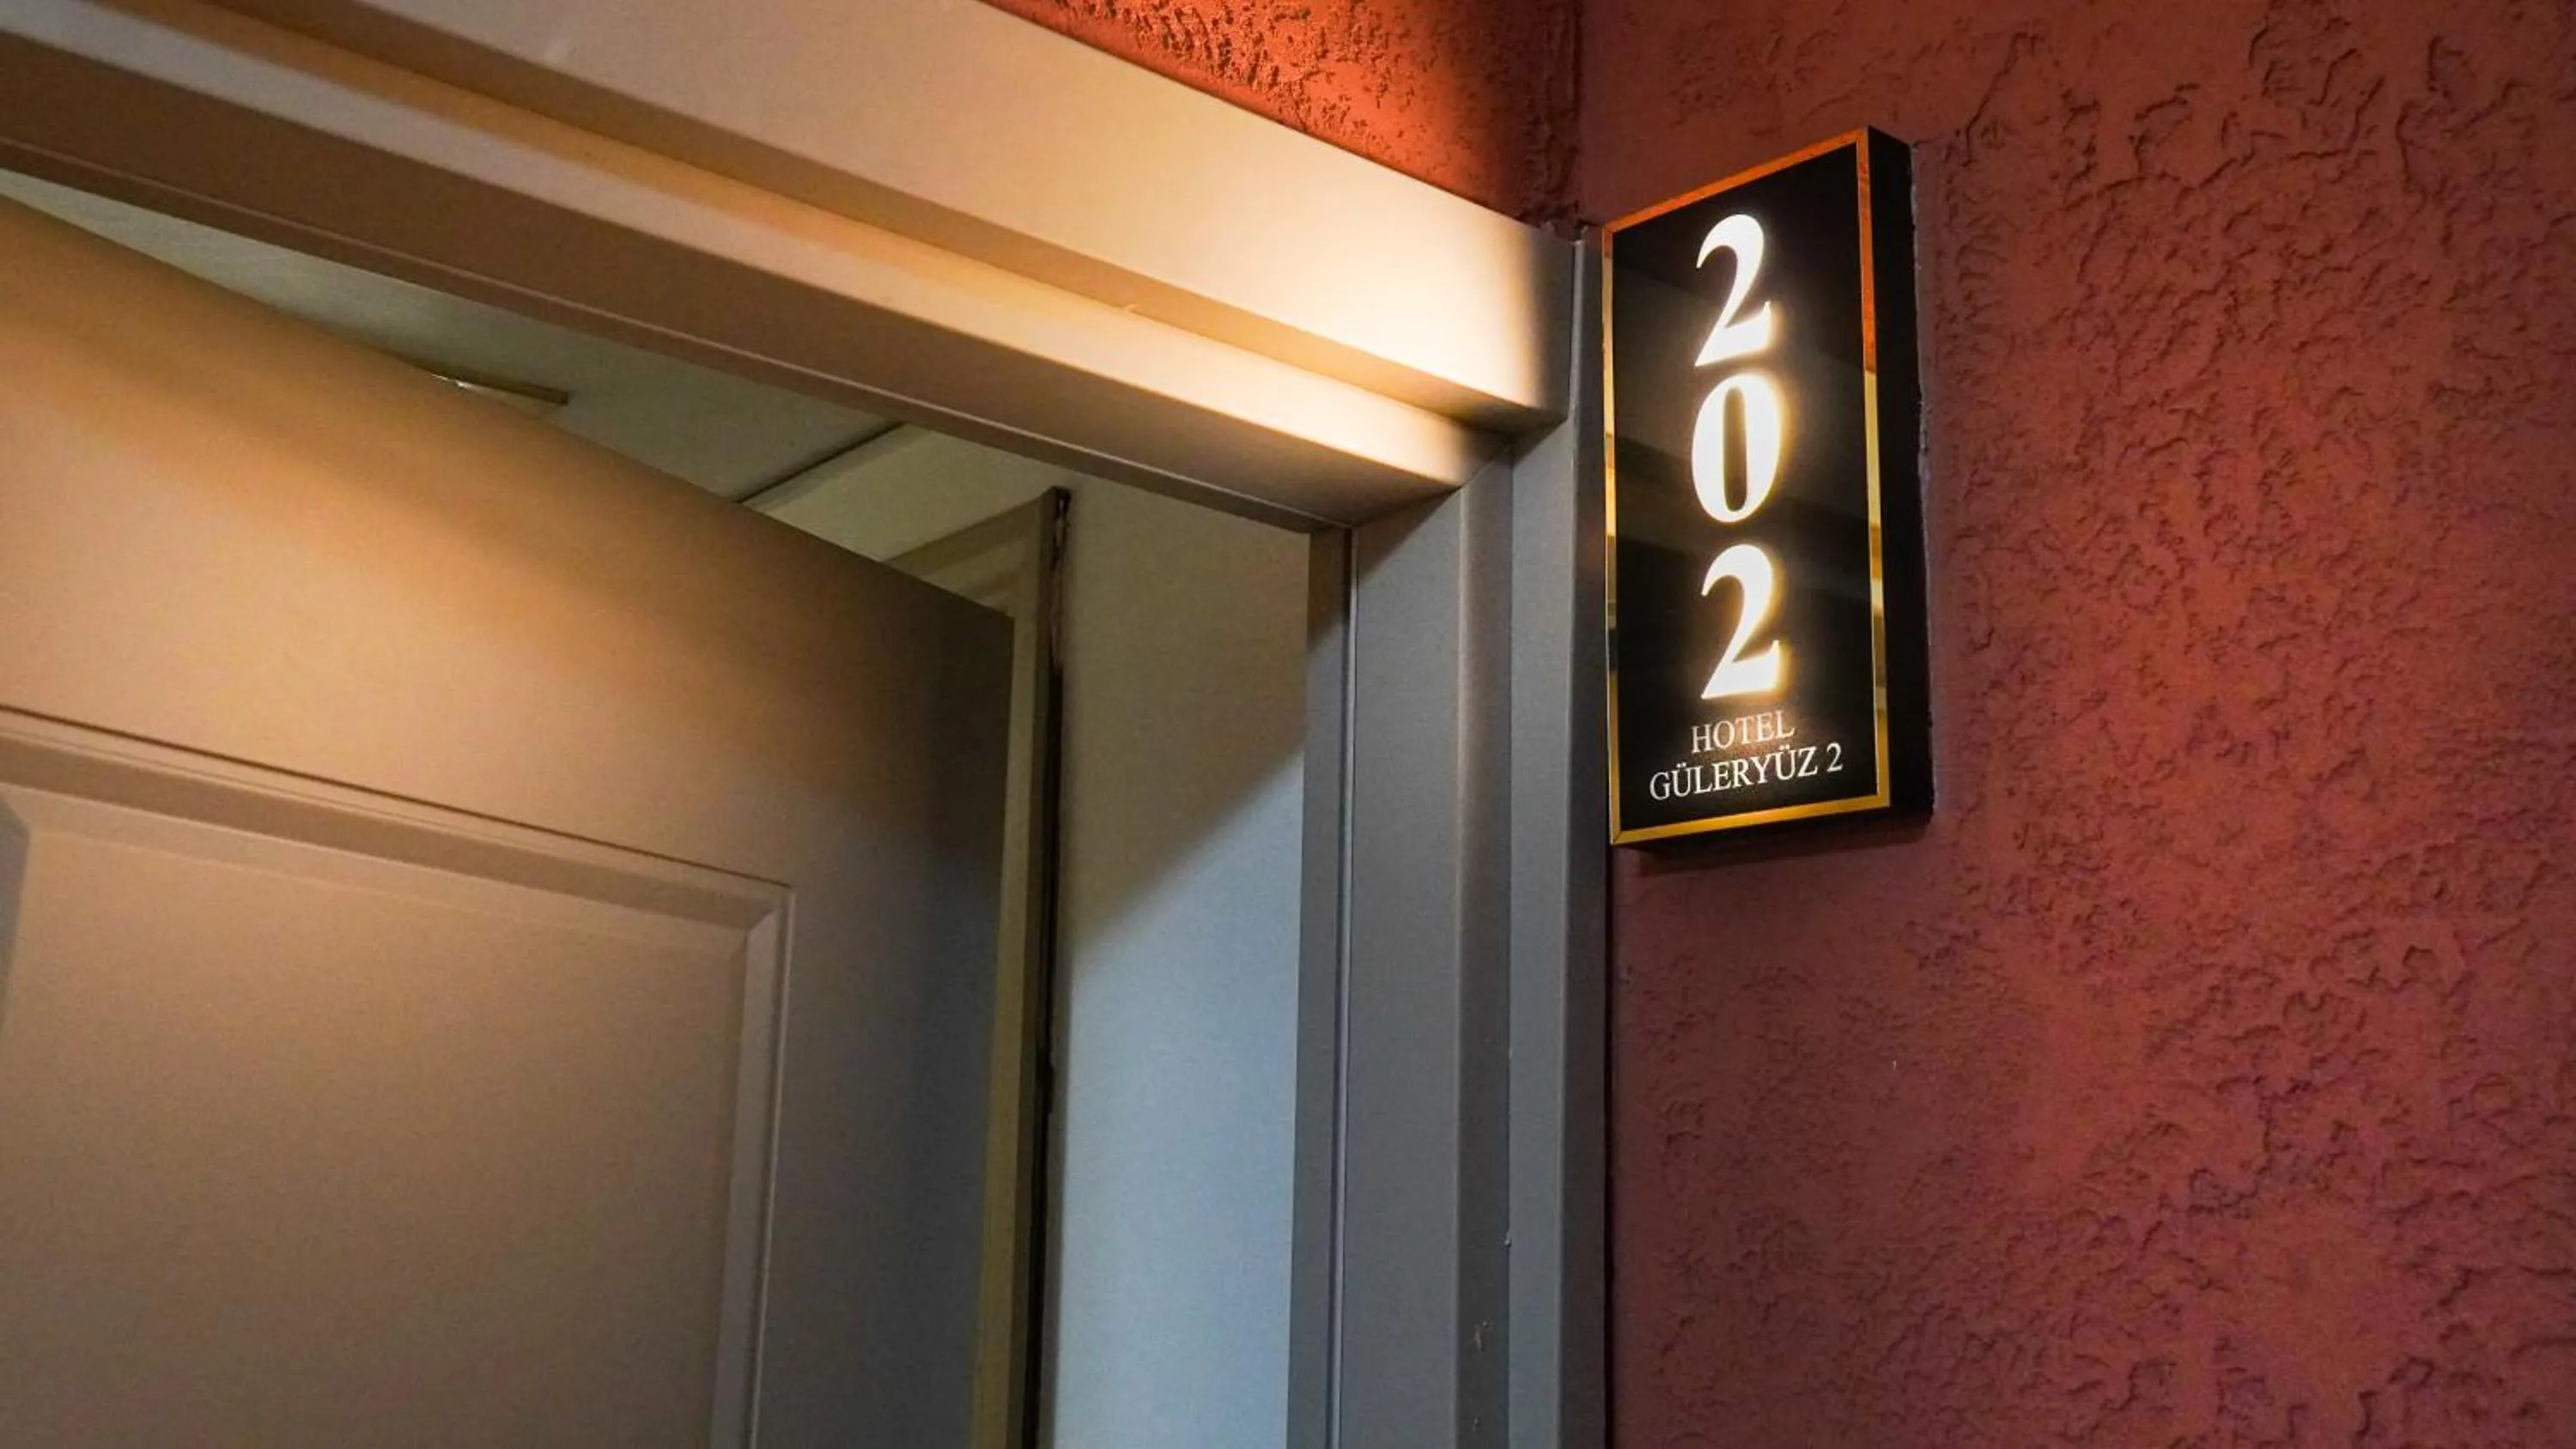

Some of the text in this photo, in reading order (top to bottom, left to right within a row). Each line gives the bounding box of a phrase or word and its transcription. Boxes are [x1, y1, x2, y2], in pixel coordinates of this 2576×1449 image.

[1692, 213, 1783, 700] 202
[1692, 709, 1795, 754] HOTEL
[1649, 742, 1844, 801] GÜLERYÜZ 2
